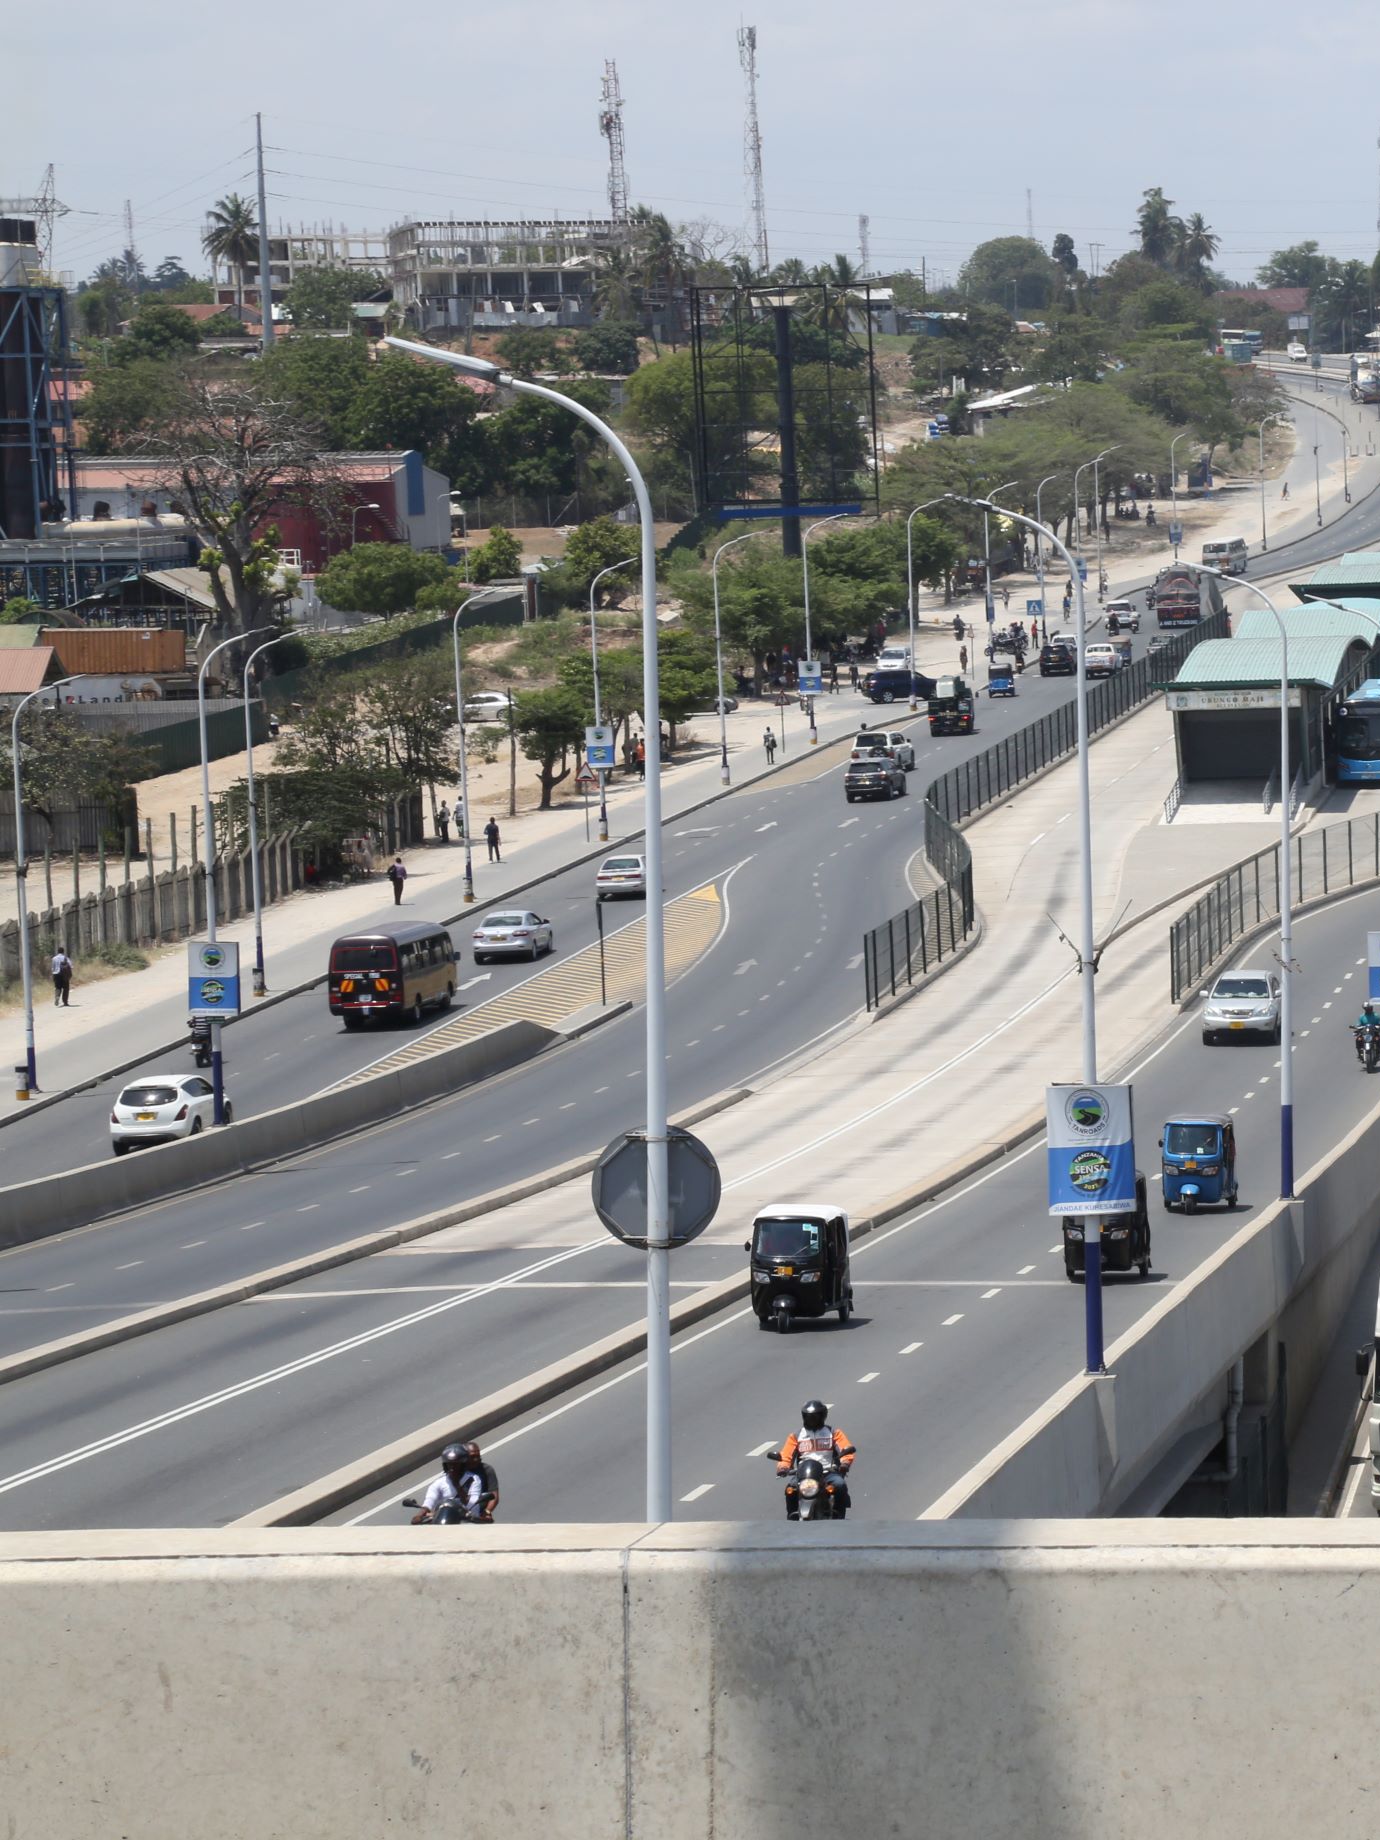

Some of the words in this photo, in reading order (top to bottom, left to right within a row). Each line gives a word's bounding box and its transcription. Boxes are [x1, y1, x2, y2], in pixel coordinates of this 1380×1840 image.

[79, 695, 123, 705] Land
[1201, 696, 1238, 704] UBUNGO
[1071, 1122, 1106, 1135] TANROADS
[1074, 1152, 1105, 1164] TANZANIA
[1074, 1164, 1106, 1174] SENSA
